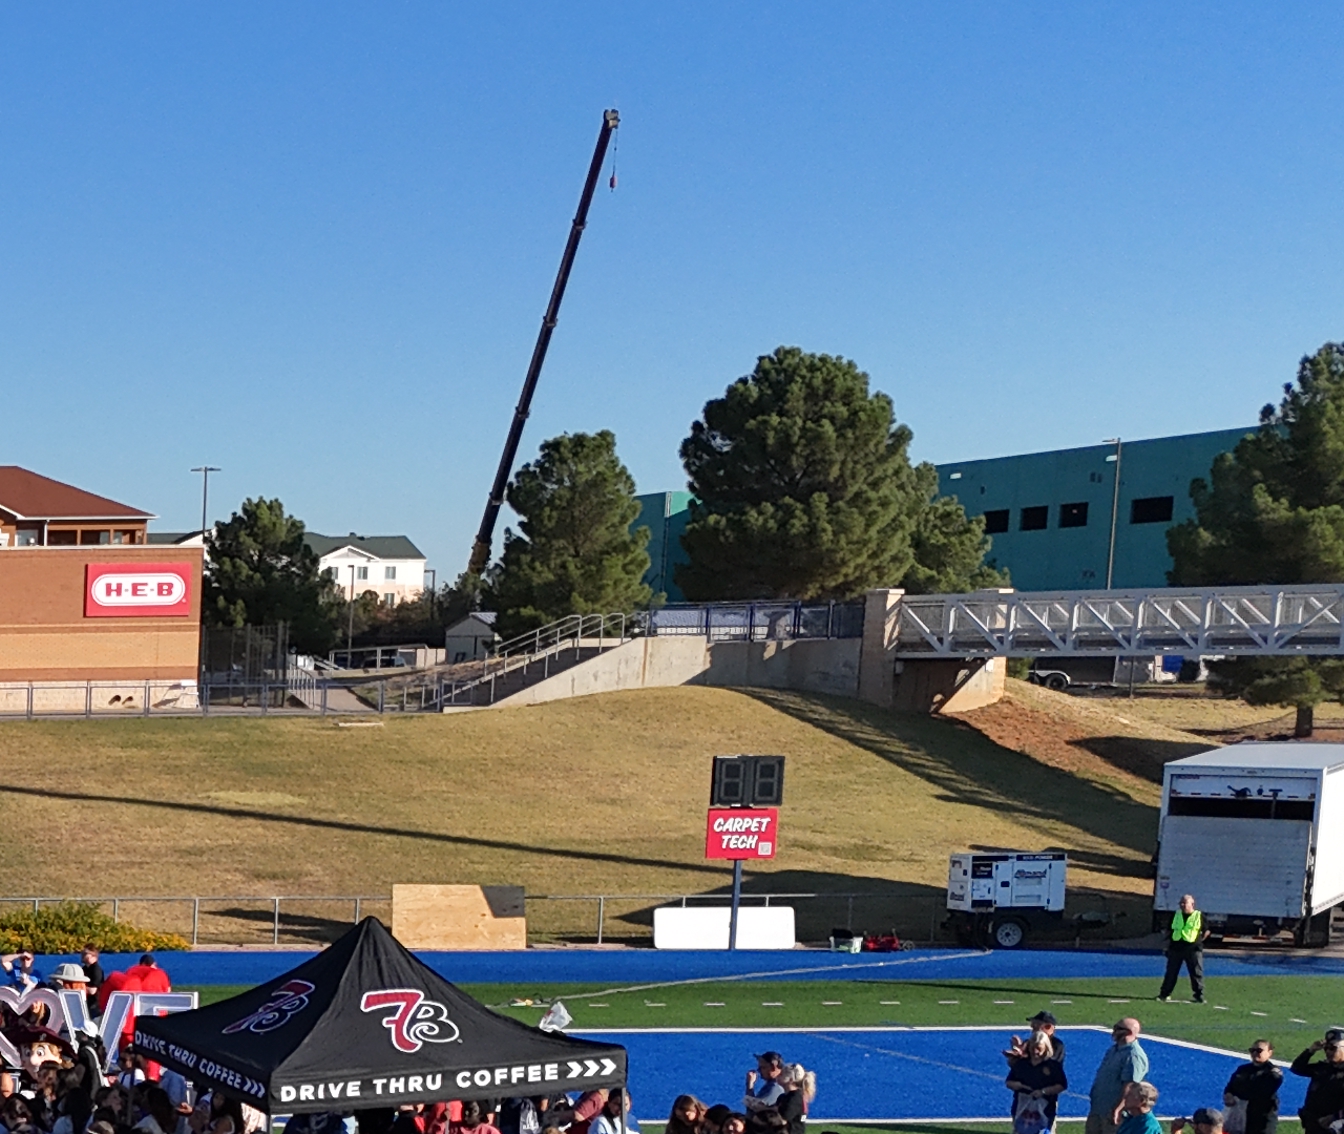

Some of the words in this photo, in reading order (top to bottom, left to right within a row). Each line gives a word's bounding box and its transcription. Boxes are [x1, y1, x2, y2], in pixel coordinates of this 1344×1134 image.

[713, 817, 771, 832] CARPET
[721, 835, 759, 849] TECH
[198, 1057, 242, 1090] COFFEE
[280, 1081, 361, 1101] DRIVE
[373, 1074, 443, 1095] THRU
[456, 1063, 559, 1088] COFFEE
